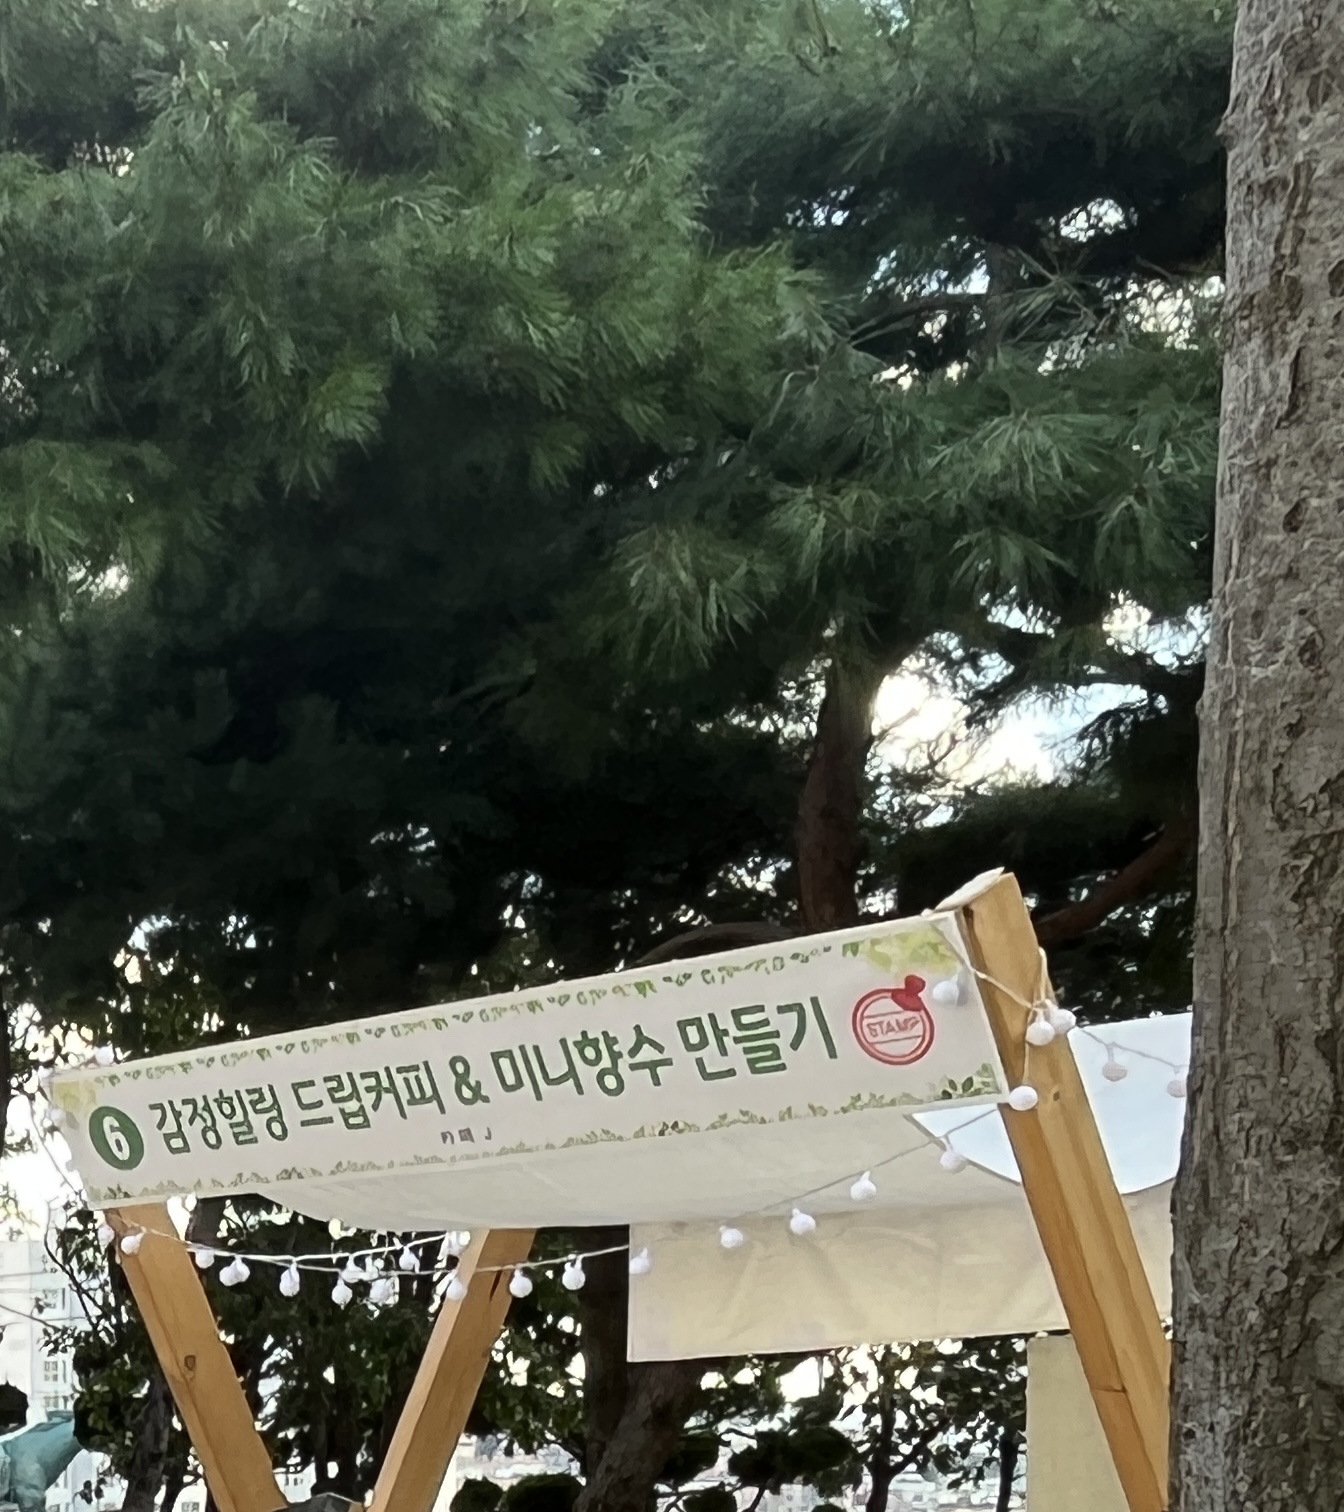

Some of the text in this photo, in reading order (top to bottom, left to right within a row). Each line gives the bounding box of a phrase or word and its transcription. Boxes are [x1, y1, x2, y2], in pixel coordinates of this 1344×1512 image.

[148, 1083, 289, 1155] 감정힐링
[290, 1060, 446, 1131] 드립커피
[453, 1054, 491, 1106] &
[490, 1022, 675, 1102] 미니향수
[676, 996, 839, 1082] 만들기
